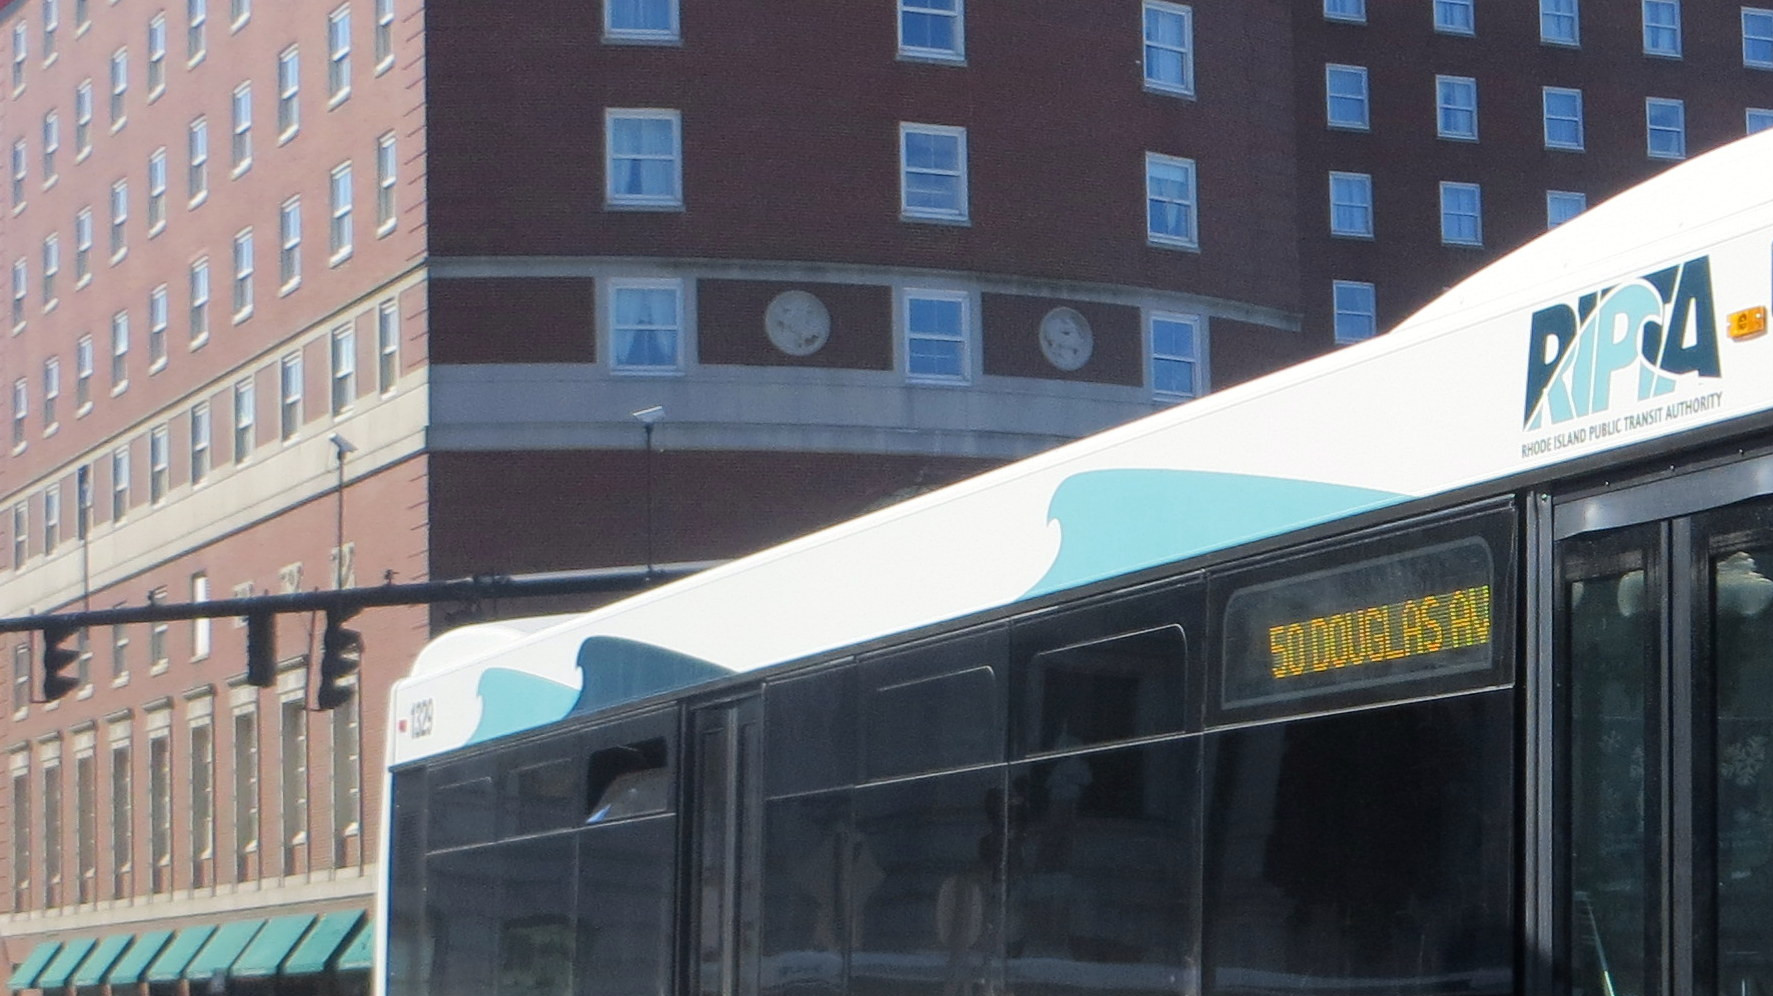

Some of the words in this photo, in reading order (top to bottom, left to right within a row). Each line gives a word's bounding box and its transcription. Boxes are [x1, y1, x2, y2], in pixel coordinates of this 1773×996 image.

[1521, 439, 1552, 458] RHODE
[1553, 428, 1587, 450] ISLAND
[1589, 419, 1620, 441] PUBLIC
[1624, 408, 1663, 431] TRANSIT
[1665, 391, 1723, 420] AUTHORITY
[1269, 622, 1305, 679] 50
[1311, 596, 1444, 673] DOUGLAS
[1450, 584, 1491, 649] AV
[410, 697, 433, 739] 1329
